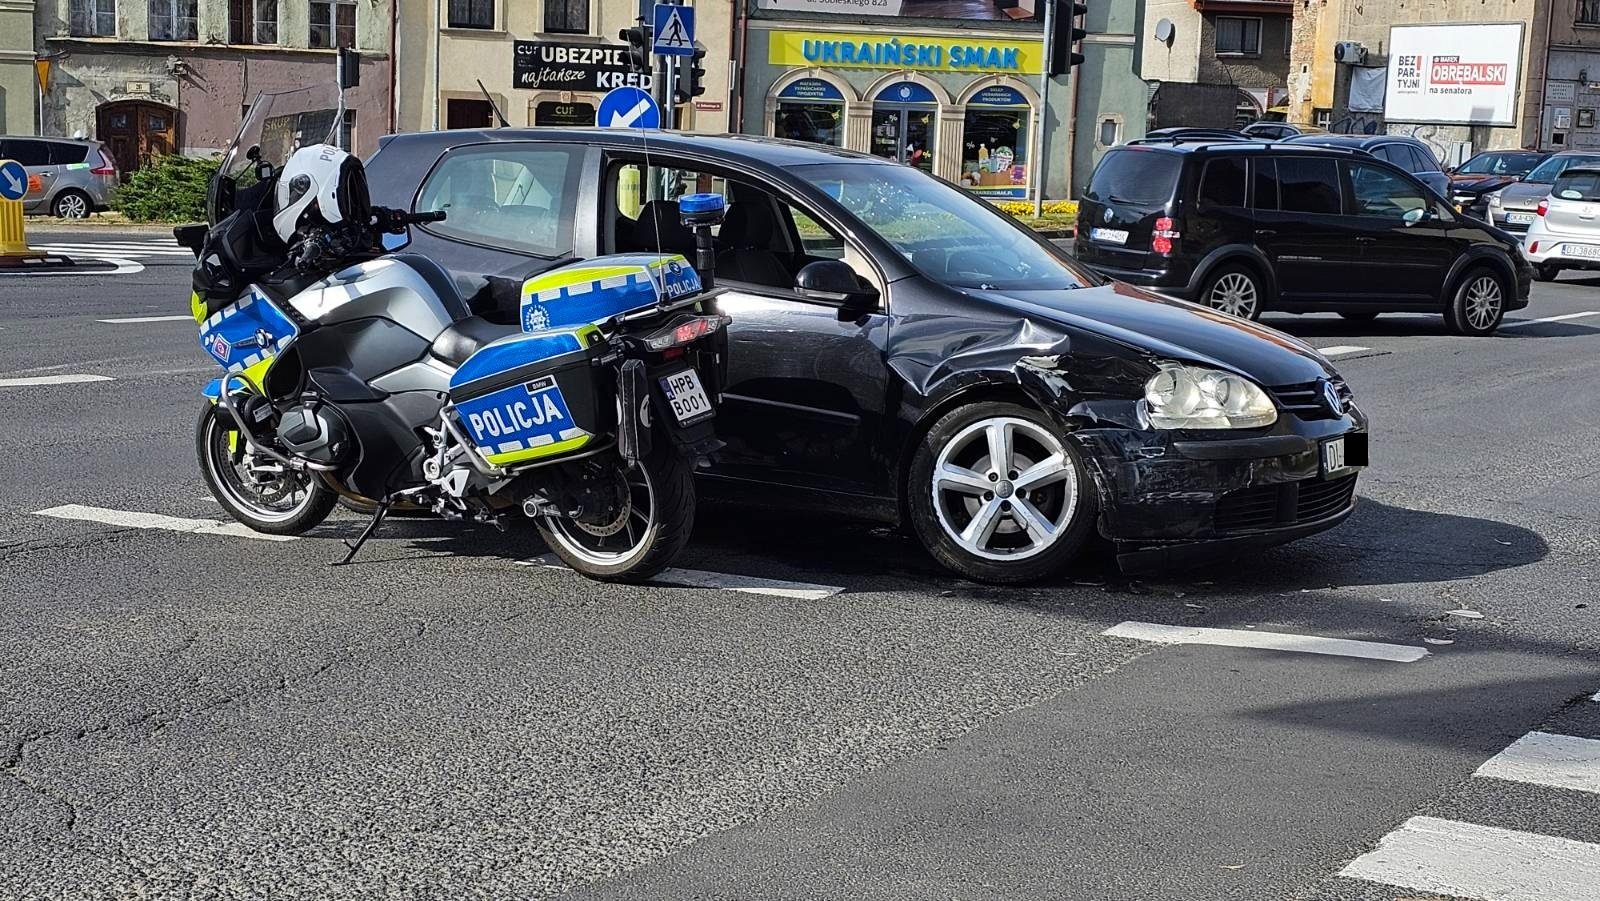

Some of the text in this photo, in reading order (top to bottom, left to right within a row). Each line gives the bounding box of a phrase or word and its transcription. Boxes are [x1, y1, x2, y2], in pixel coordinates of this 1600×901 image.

[803, 38, 1019, 69] UKRAIŃSKI SMAK
[1398, 56, 1416, 66] BEZ
[521, 67, 586, 88] najtańsze
[596, 71, 653, 90] KRED
[1397, 68, 1415, 77] PAR
[1432, 65, 1506, 84] OBRĘBALSKI
[1397, 80, 1420, 88] TYJNI
[1440, 87, 1472, 95] senatora
[667, 279, 703, 300] POLICJA
[671, 375, 695, 395] HPB
[674, 392, 707, 416] B001
[468, 393, 565, 441] POLICJA
